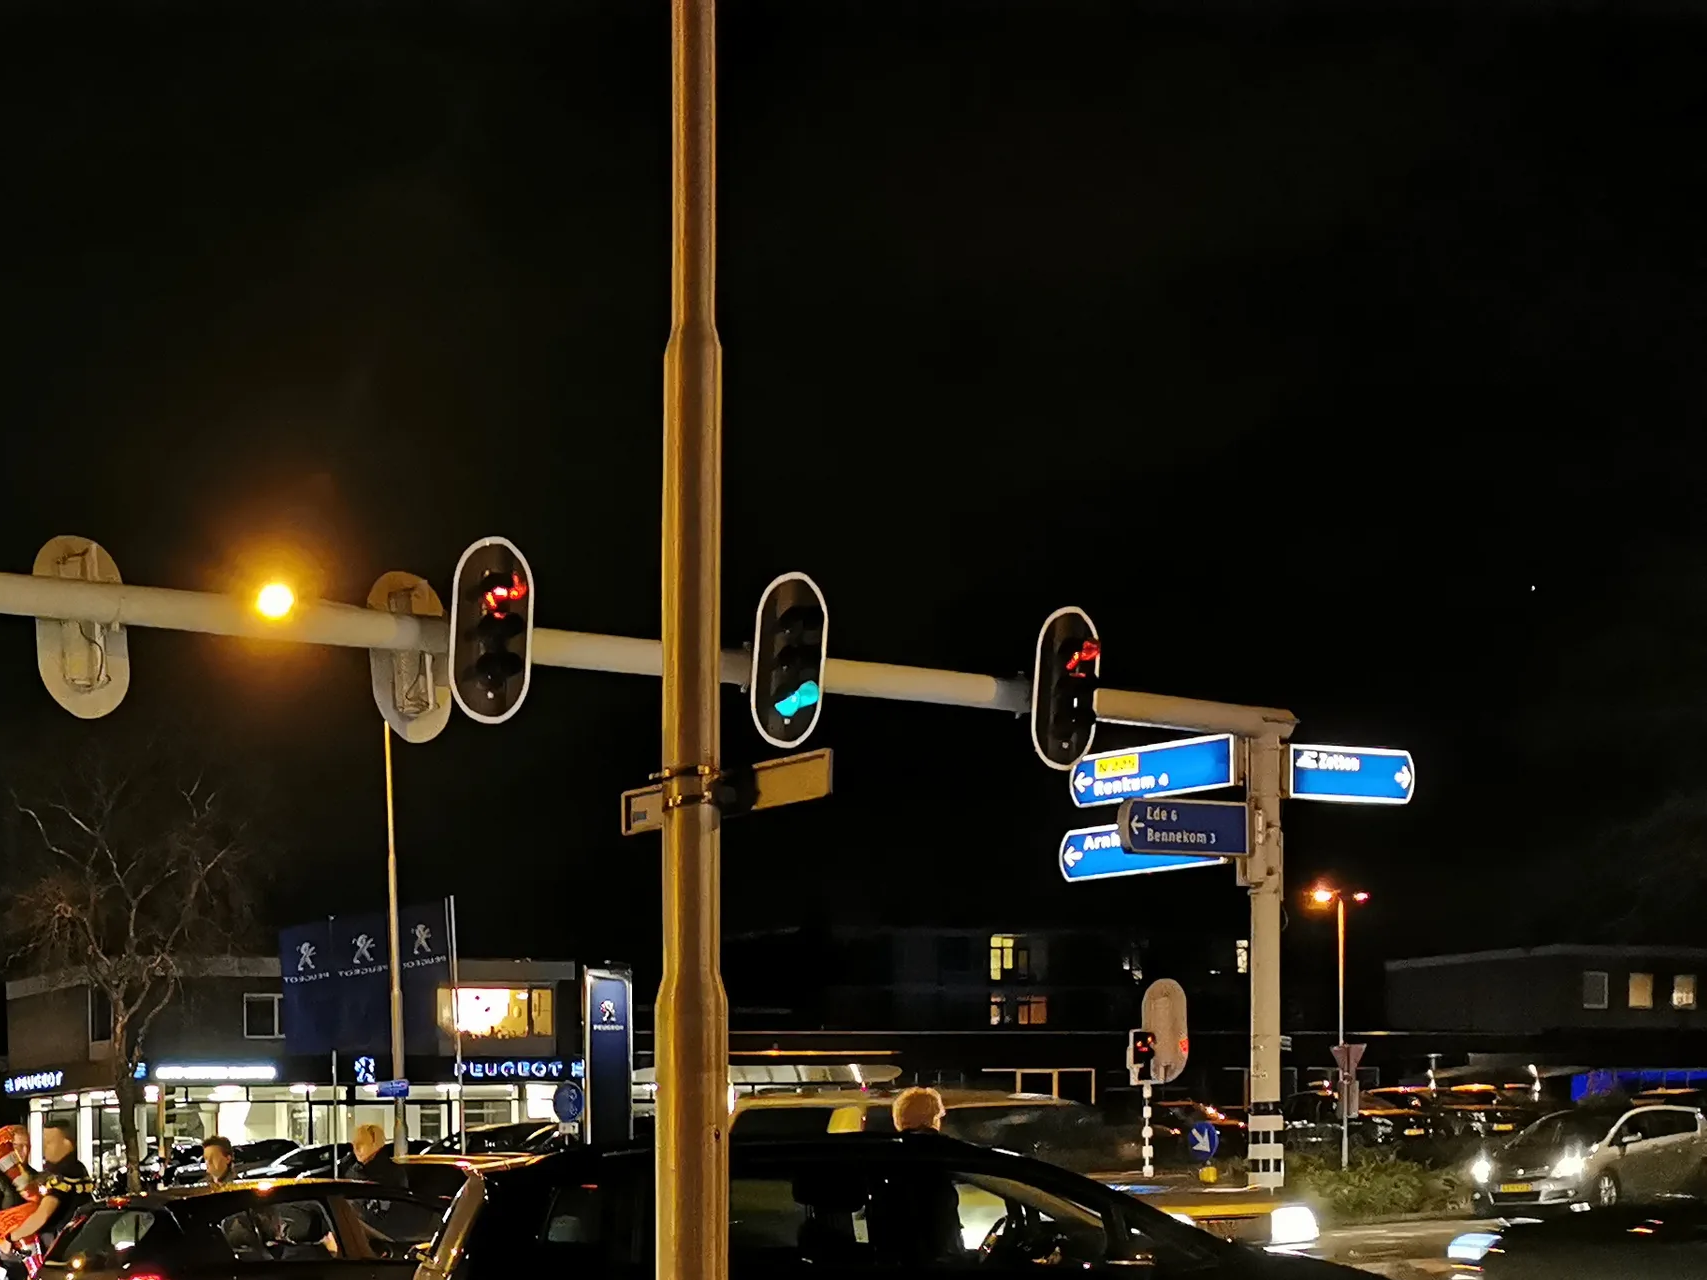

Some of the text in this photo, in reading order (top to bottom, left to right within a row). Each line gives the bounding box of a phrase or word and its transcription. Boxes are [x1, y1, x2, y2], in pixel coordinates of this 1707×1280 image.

[1094, 776, 1155, 796] Renkum
[1146, 806, 1178, 821] Ede 6
[1083, 832, 1121, 850] Arnh
[1146, 828, 1216, 844] Bennekom 3
[454, 1061, 563, 1077] PEUGEOT
[14, 1071, 63, 1091] PEUGEOT
